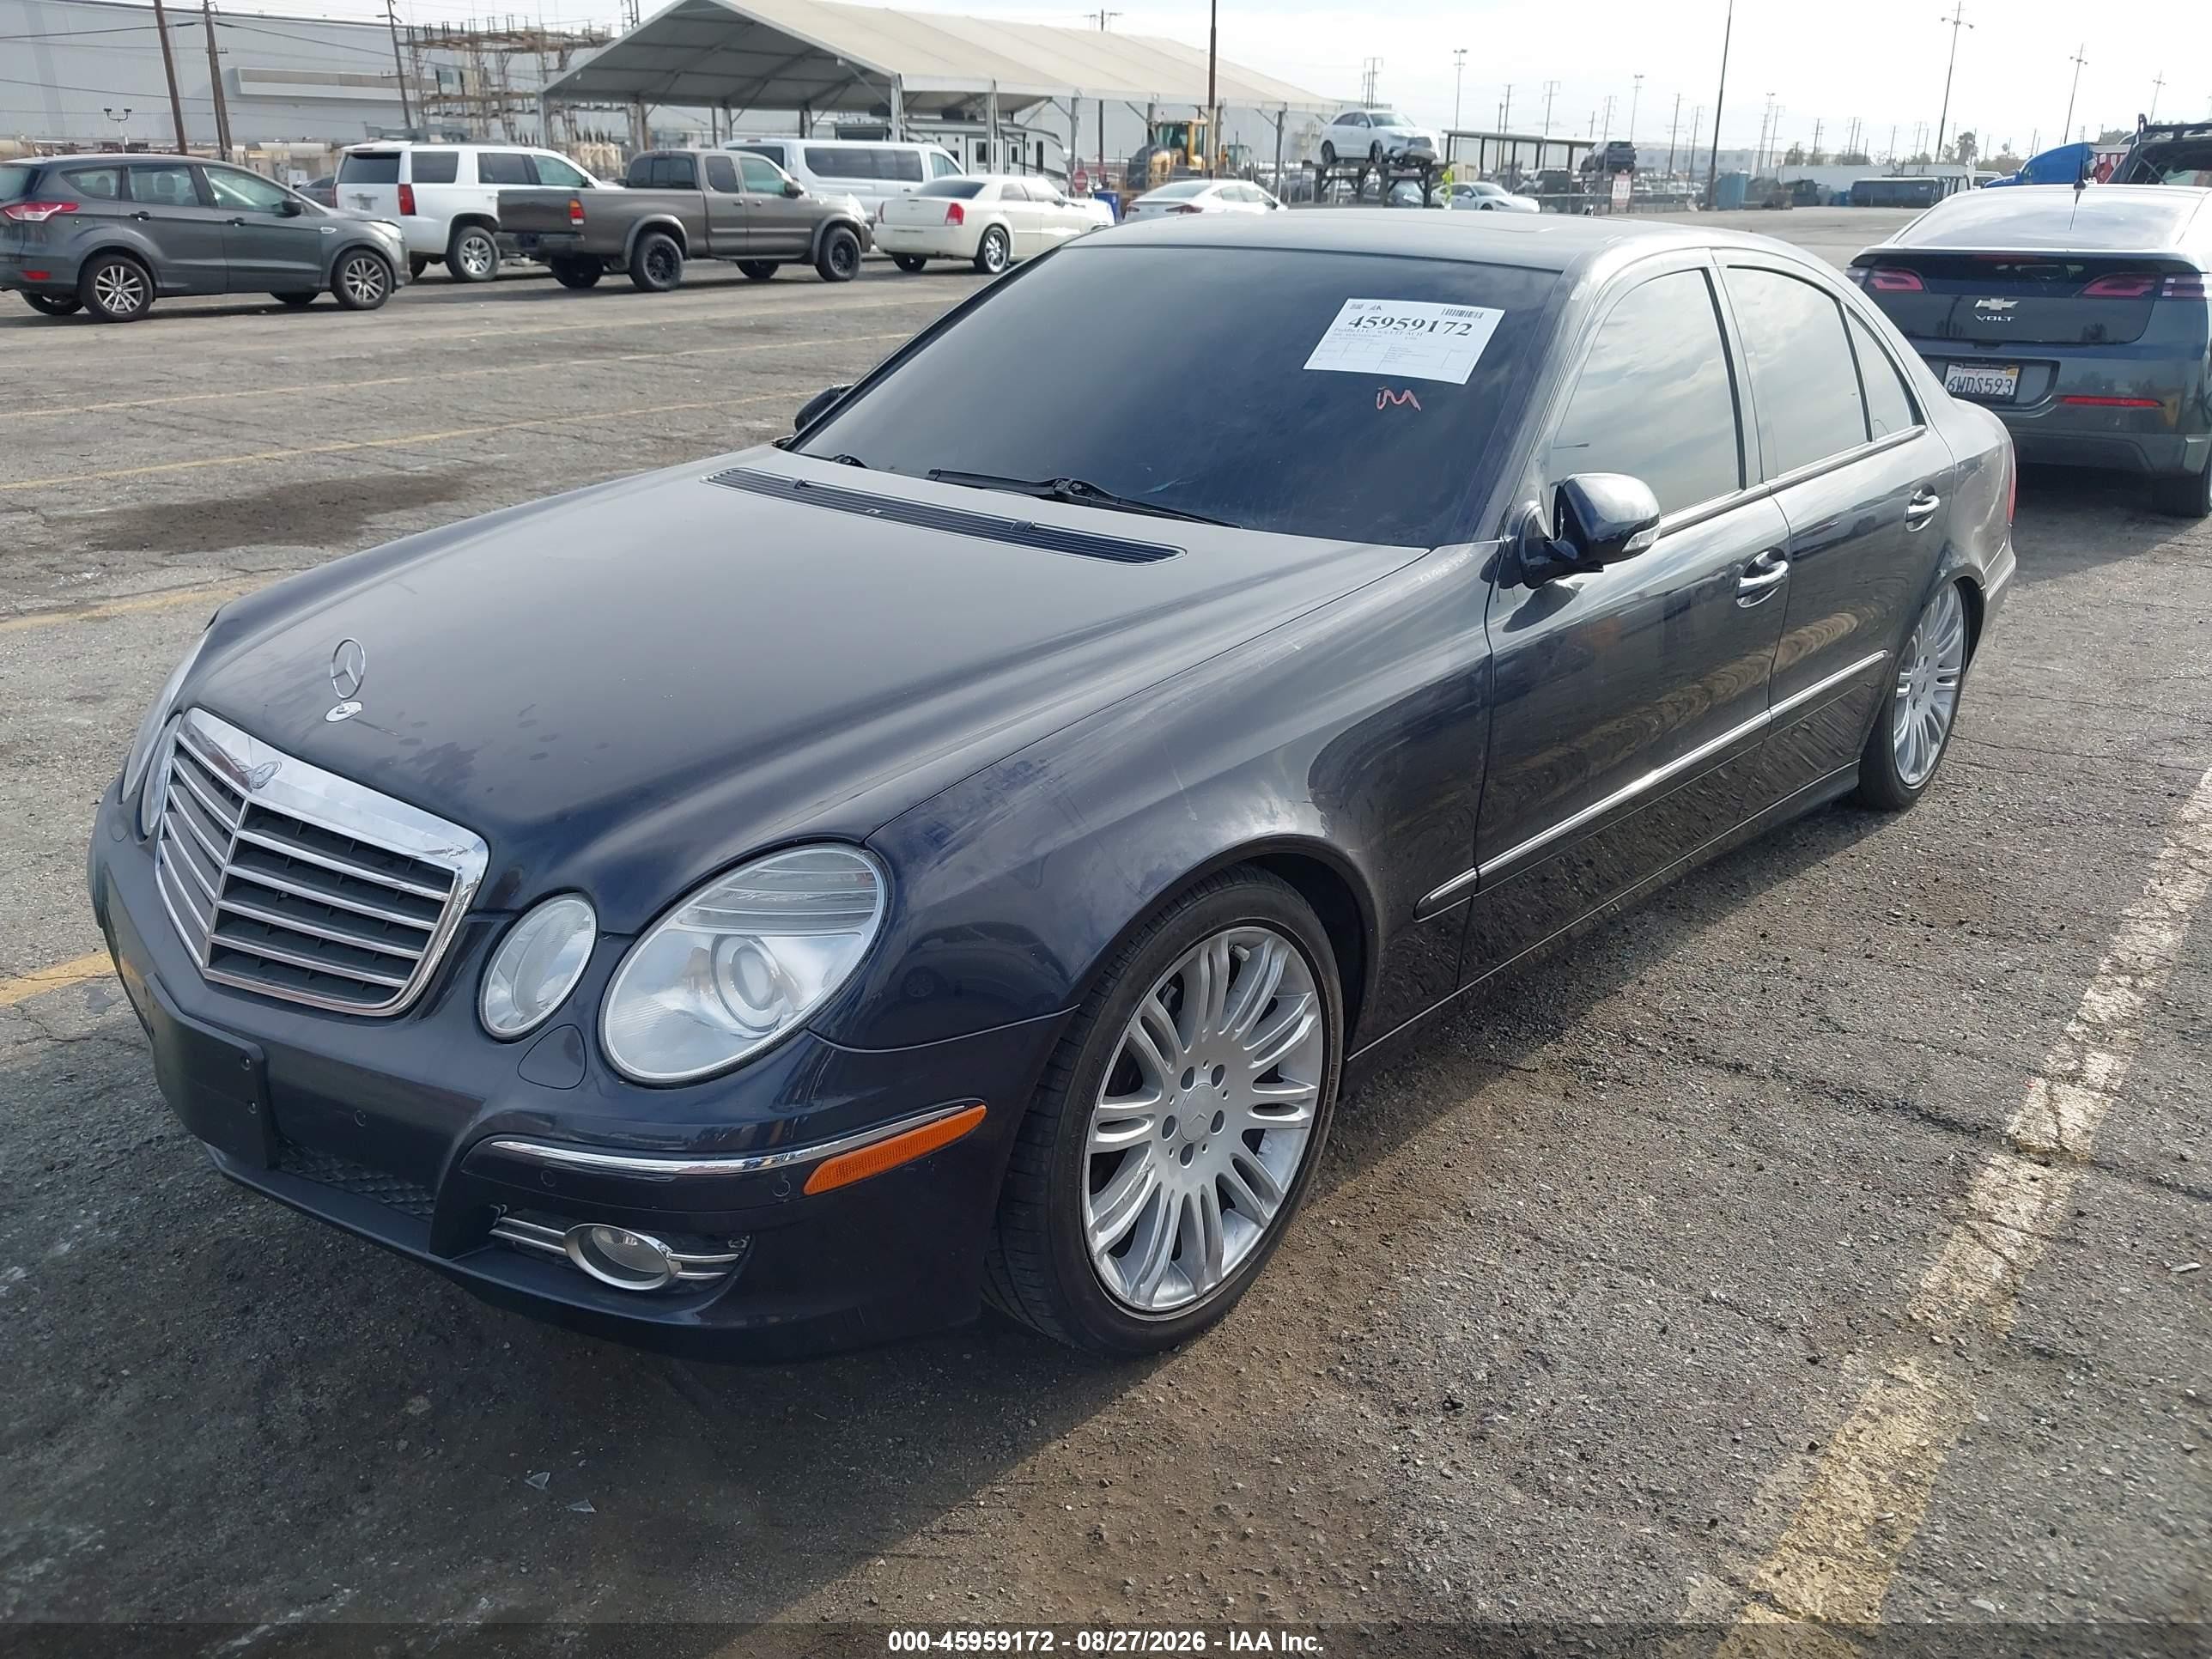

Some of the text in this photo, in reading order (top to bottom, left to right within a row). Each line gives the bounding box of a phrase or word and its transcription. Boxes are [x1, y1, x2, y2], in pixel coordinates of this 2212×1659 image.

[1348, 315, 1473, 336] 45959172
[1974, 313, 2015, 322] VOLT
[1947, 376, 2013, 394] 6WDS593
